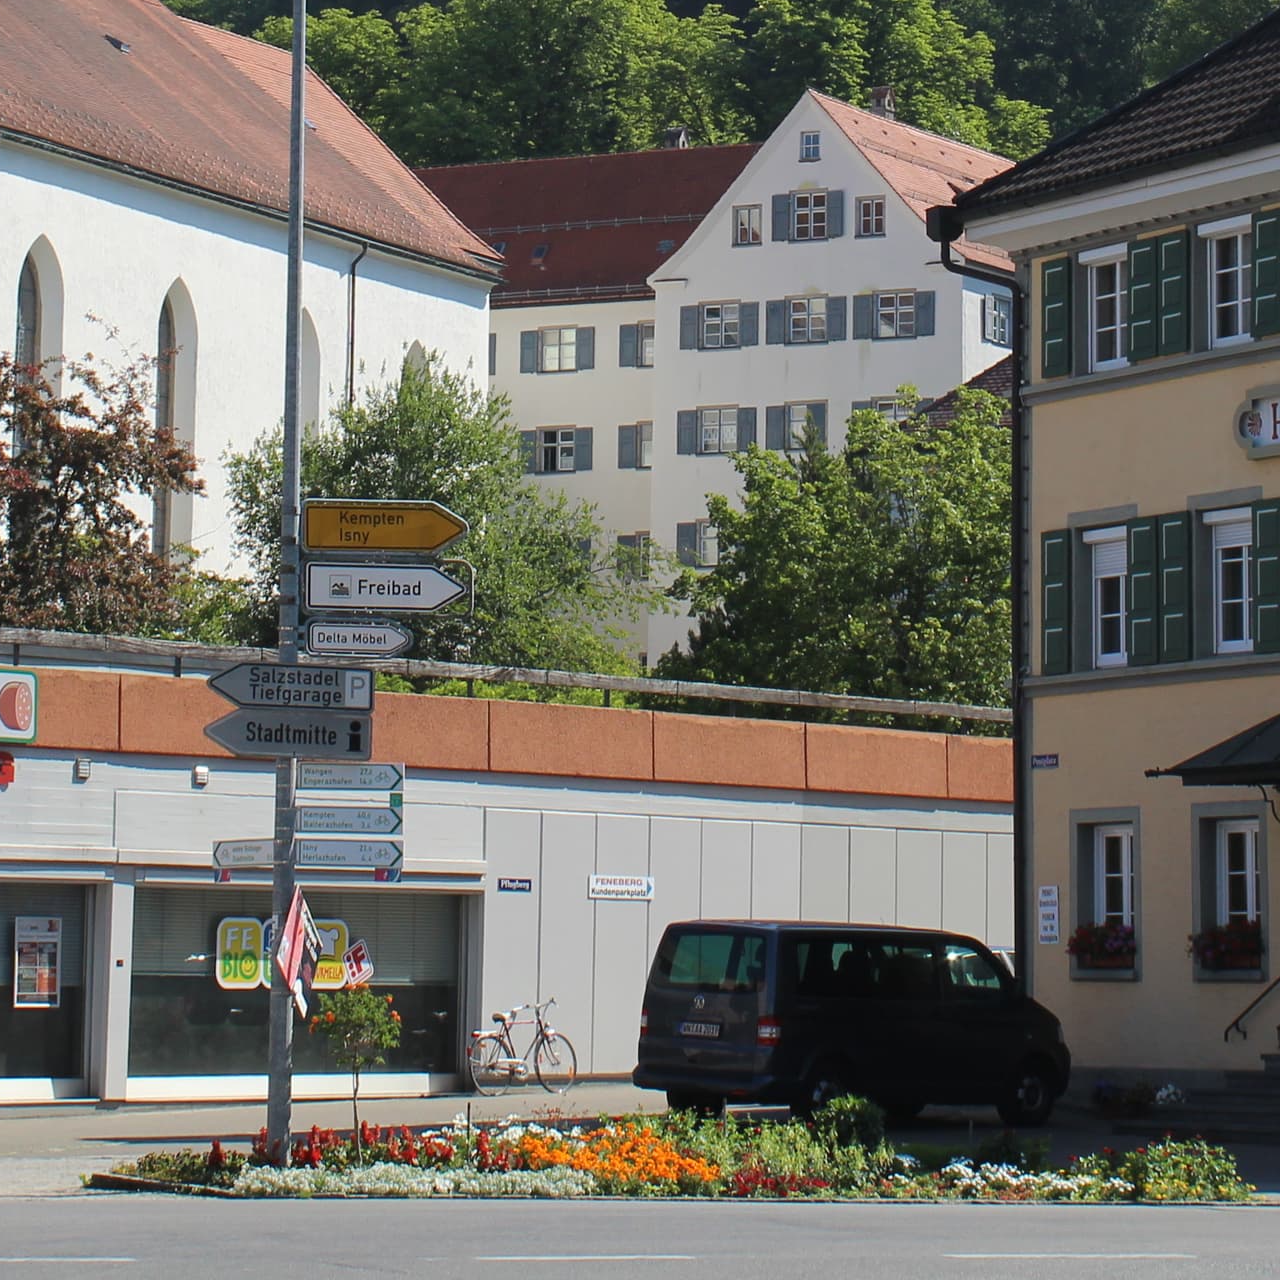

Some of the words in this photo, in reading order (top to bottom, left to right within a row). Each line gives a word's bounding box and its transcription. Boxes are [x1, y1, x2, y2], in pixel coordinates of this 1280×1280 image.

[339, 511, 405, 527] Kempten
[339, 528, 370, 544] Isny
[358, 579, 421, 596] Freibad
[317, 631, 348, 644] Delta
[352, 633, 387, 645] Möbel
[249, 666, 339, 687] Salzstadel
[249, 684, 343, 707] Tiefgarage
[245, 720, 337, 746] Stadtmitte
[595, 877, 643, 887] FENEBERG
[591, 887, 647, 898] Kundenparkplatz
[225, 927, 254, 951] FE
[222, 952, 258, 980] BIO
